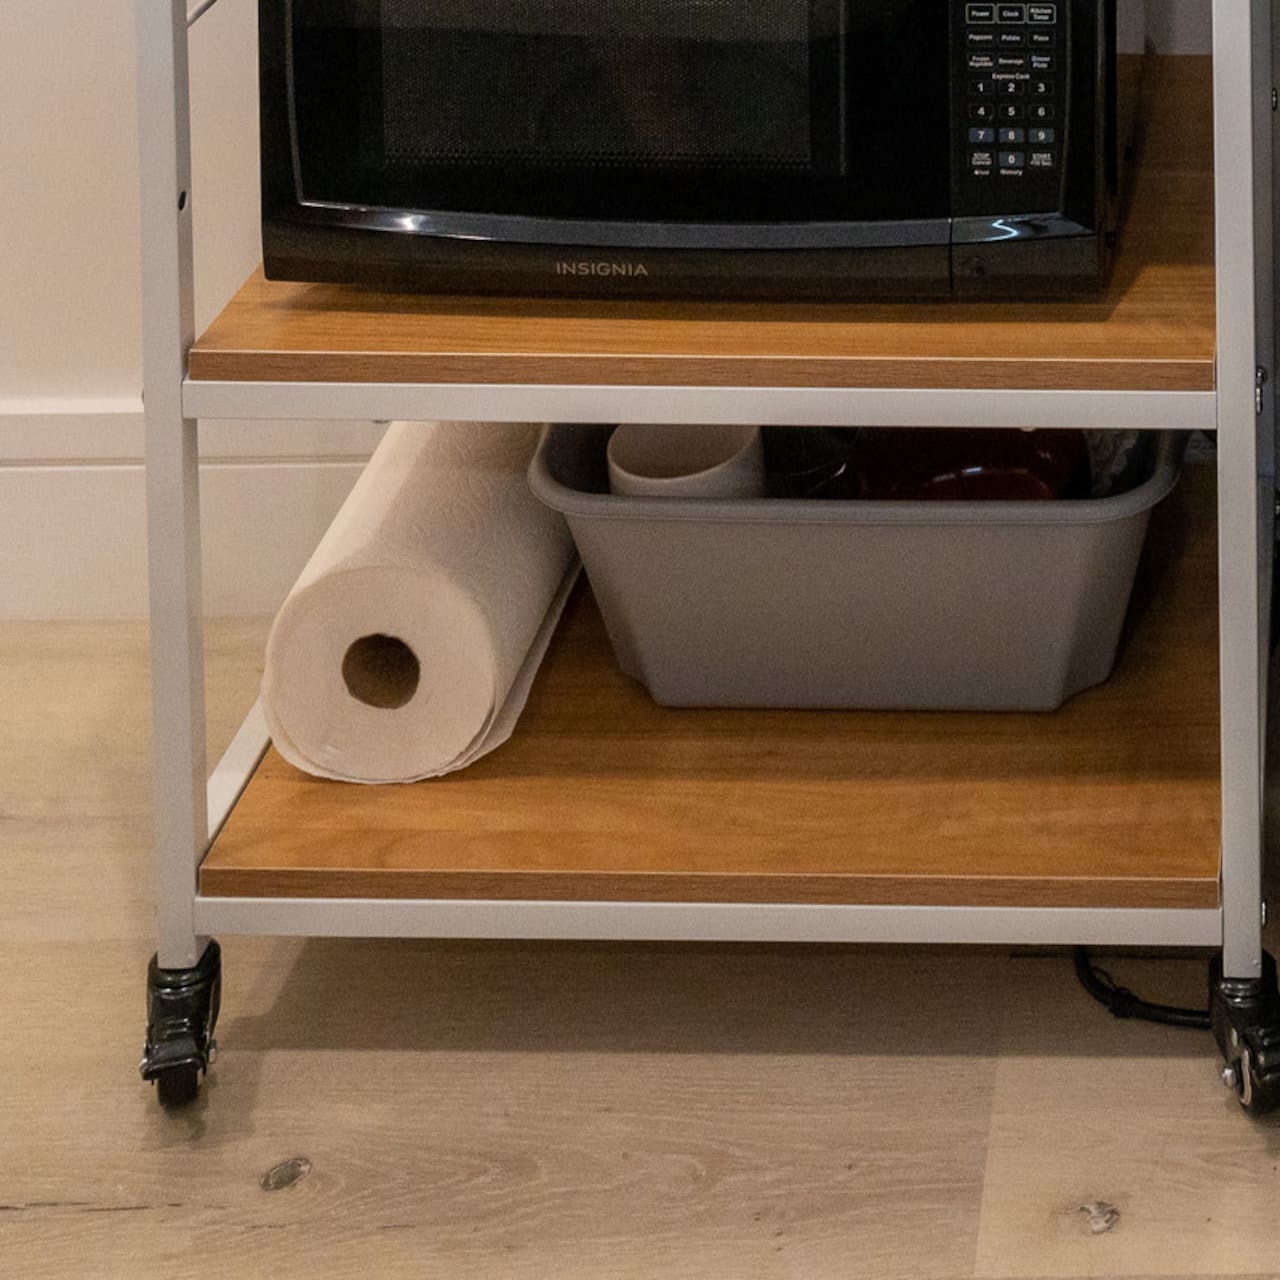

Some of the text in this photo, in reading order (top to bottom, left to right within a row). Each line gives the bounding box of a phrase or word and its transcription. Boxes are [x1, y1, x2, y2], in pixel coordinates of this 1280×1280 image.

[977, 82, 984, 92] 1
[1008, 82, 1015, 92] 2
[1038, 82, 1045, 92] 3
[977, 106, 985, 115] 4
[1008, 106, 1015, 116] 5
[1038, 106, 1045, 116] 6
[977, 130, 985, 139] 7
[1008, 130, 1015, 140] 8
[1038, 130, 1045, 140] 9
[1008, 154, 1015, 164] 0
[556, 261, 649, 277] INSIGNIA
